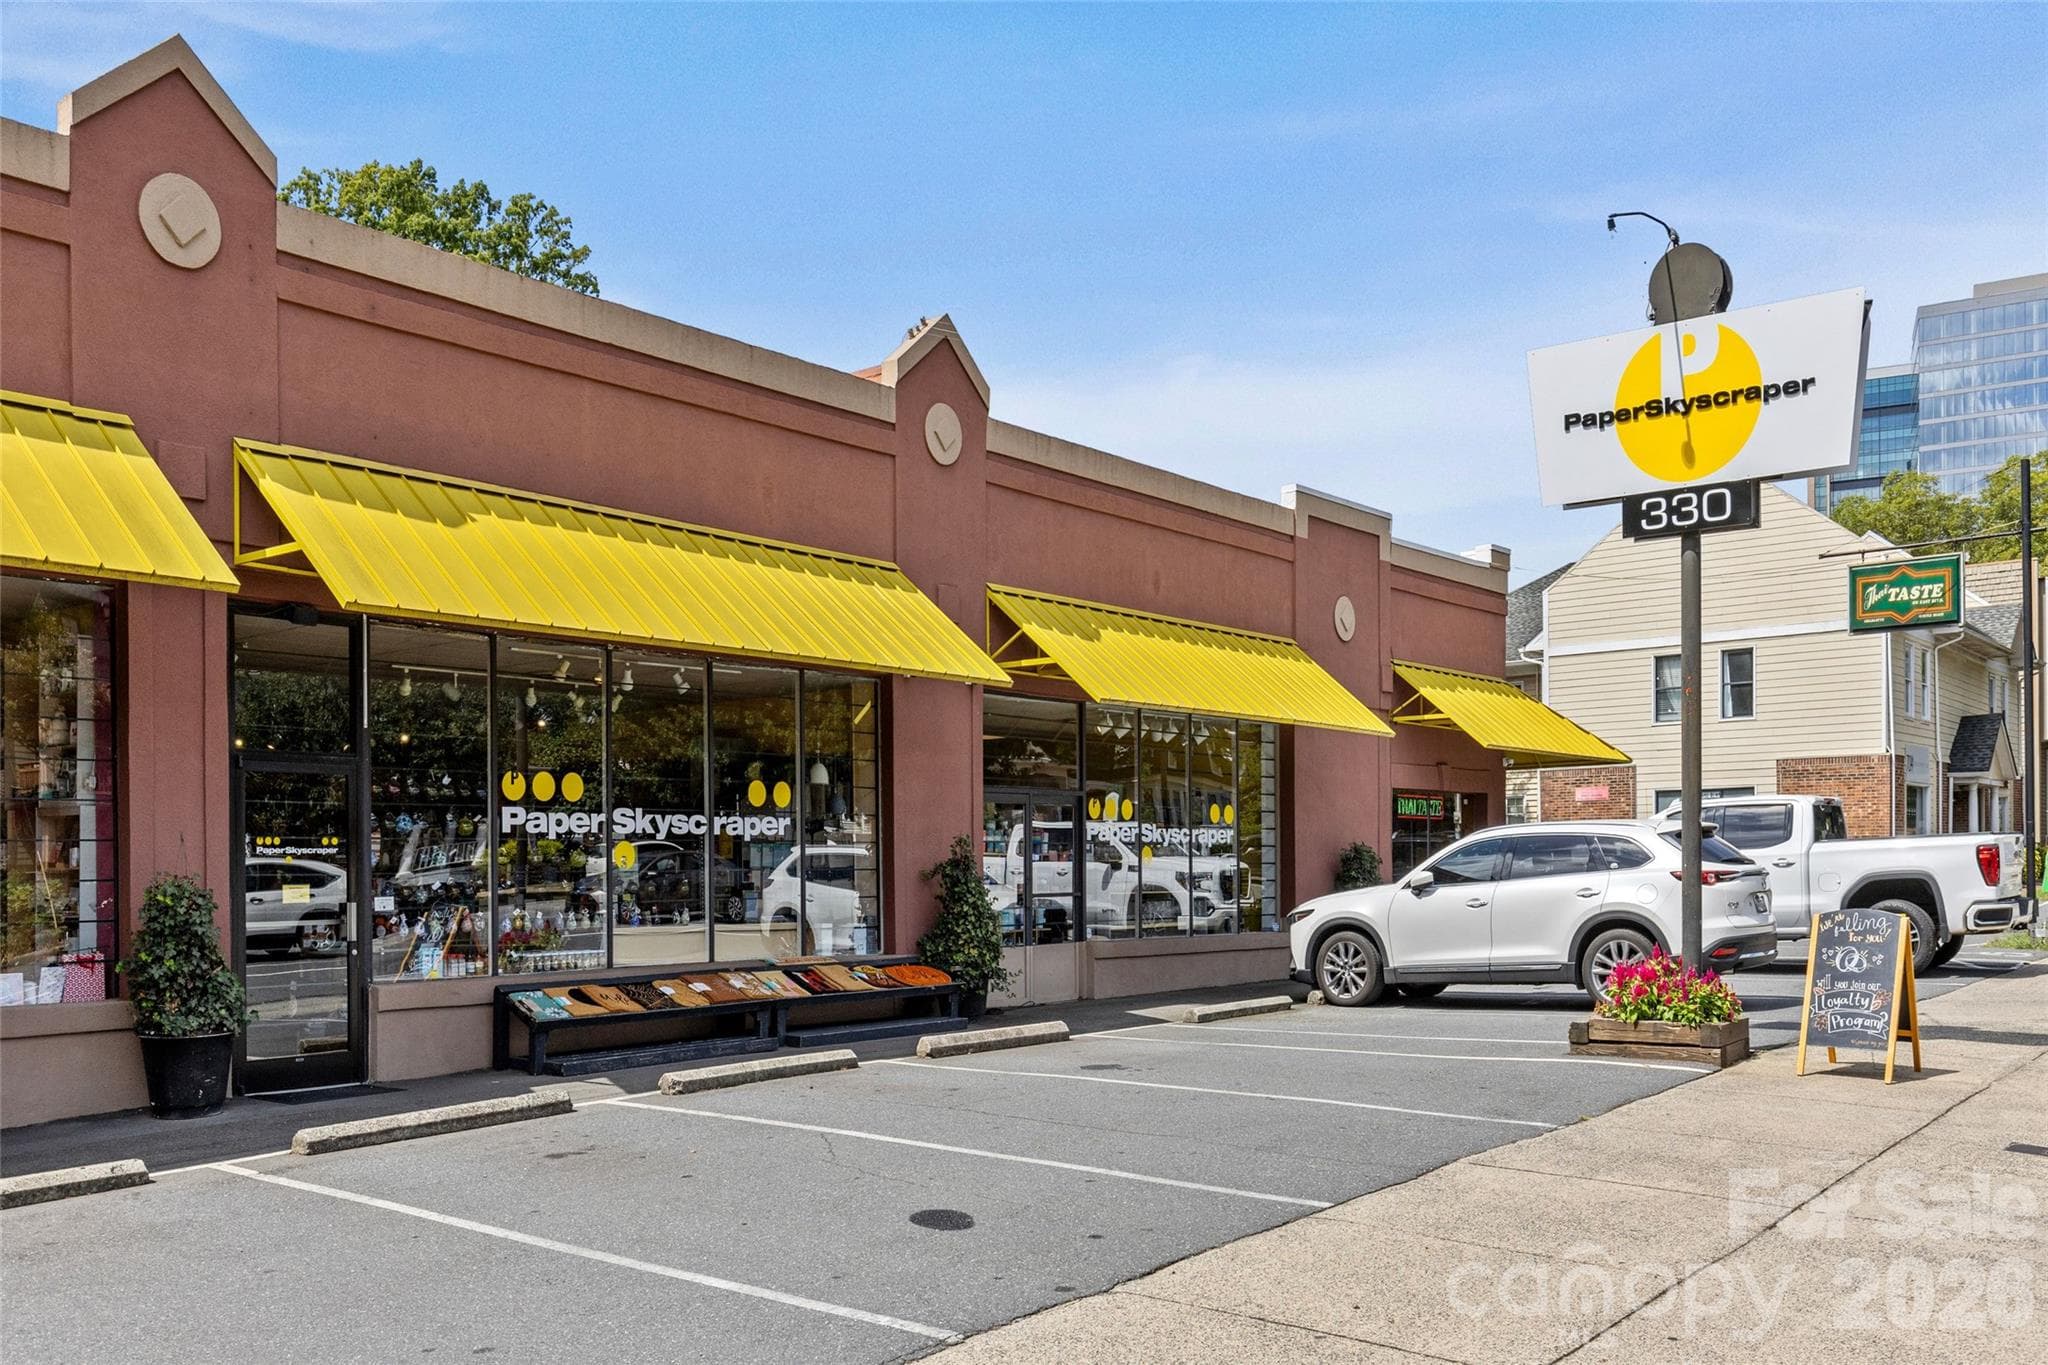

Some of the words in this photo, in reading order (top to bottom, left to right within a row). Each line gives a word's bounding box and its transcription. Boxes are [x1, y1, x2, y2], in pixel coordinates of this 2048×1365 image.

[1563, 376, 1817, 434] PaperSkyscraper
[1640, 487, 1732, 531] 330
[1863, 583, 1889, 610] Thai
[1887, 583, 1944, 602] TASTE
[1416, 799, 1442, 816] TATE
[255, 846, 339, 856] PaperSkyscraper
